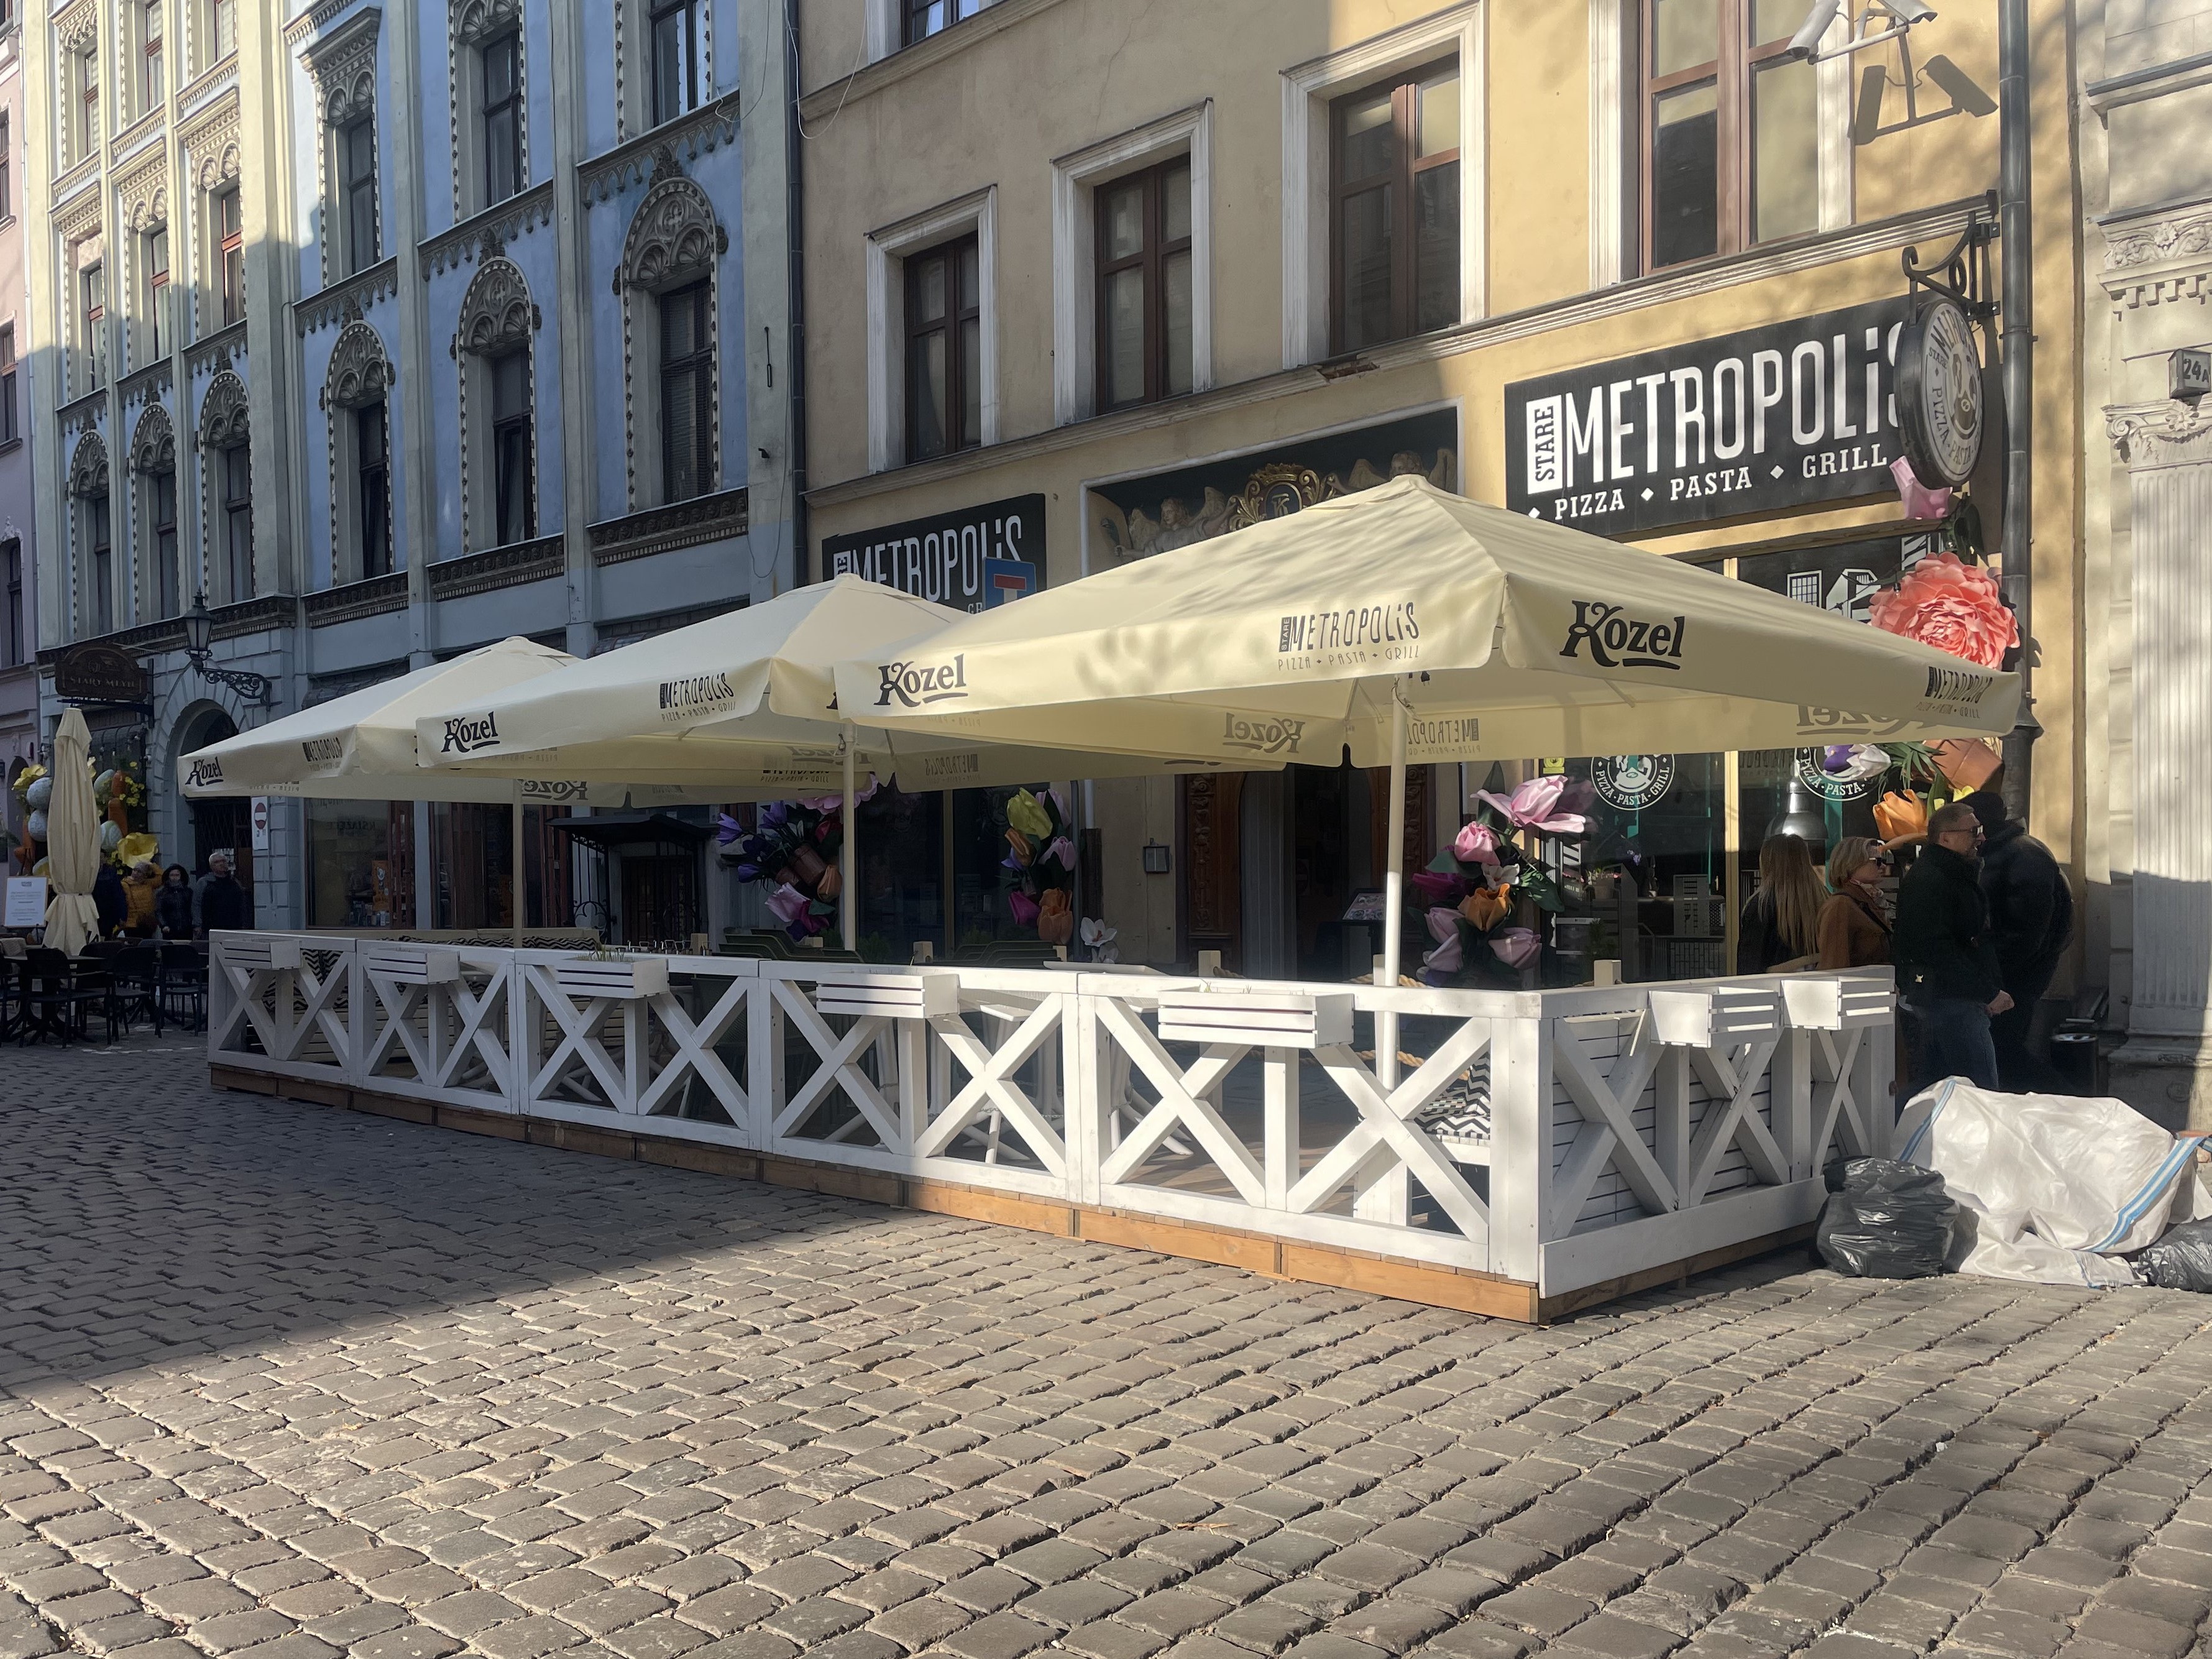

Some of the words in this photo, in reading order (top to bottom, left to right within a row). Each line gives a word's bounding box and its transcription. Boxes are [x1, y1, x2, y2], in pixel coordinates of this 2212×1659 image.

[2183, 358, 2210, 384] 24A
[1535, 405, 1554, 482] STARE
[1554, 488, 1625, 520] PIZZA
[1670, 466, 1752, 501] PASTA
[1802, 443, 1888, 479] GRILL
[1281, 618, 1291, 651] STARE
[1559, 600, 1685, 669] Kozel
[1278, 656, 1311, 671] PIZZA
[1329, 651, 1367, 666] PASTA
[1385, 645, 1419, 660] GRILL
[873, 653, 968, 707] Kozel
[661, 711, 681, 722] PIZZA
[687, 705, 710, 717] PASTA
[1959, 706, 1981, 719] GRILL
[440, 711, 500, 753] Kozel
[184, 756, 224, 786] Kozel
[1595, 770, 1615, 799] PIZZA
[1616, 793, 1649, 806] PASTA
[1649, 766, 1671, 796] GRILL
[1800, 758, 1822, 789] PIZZA
[1824, 781, 1863, 796] PASTA
